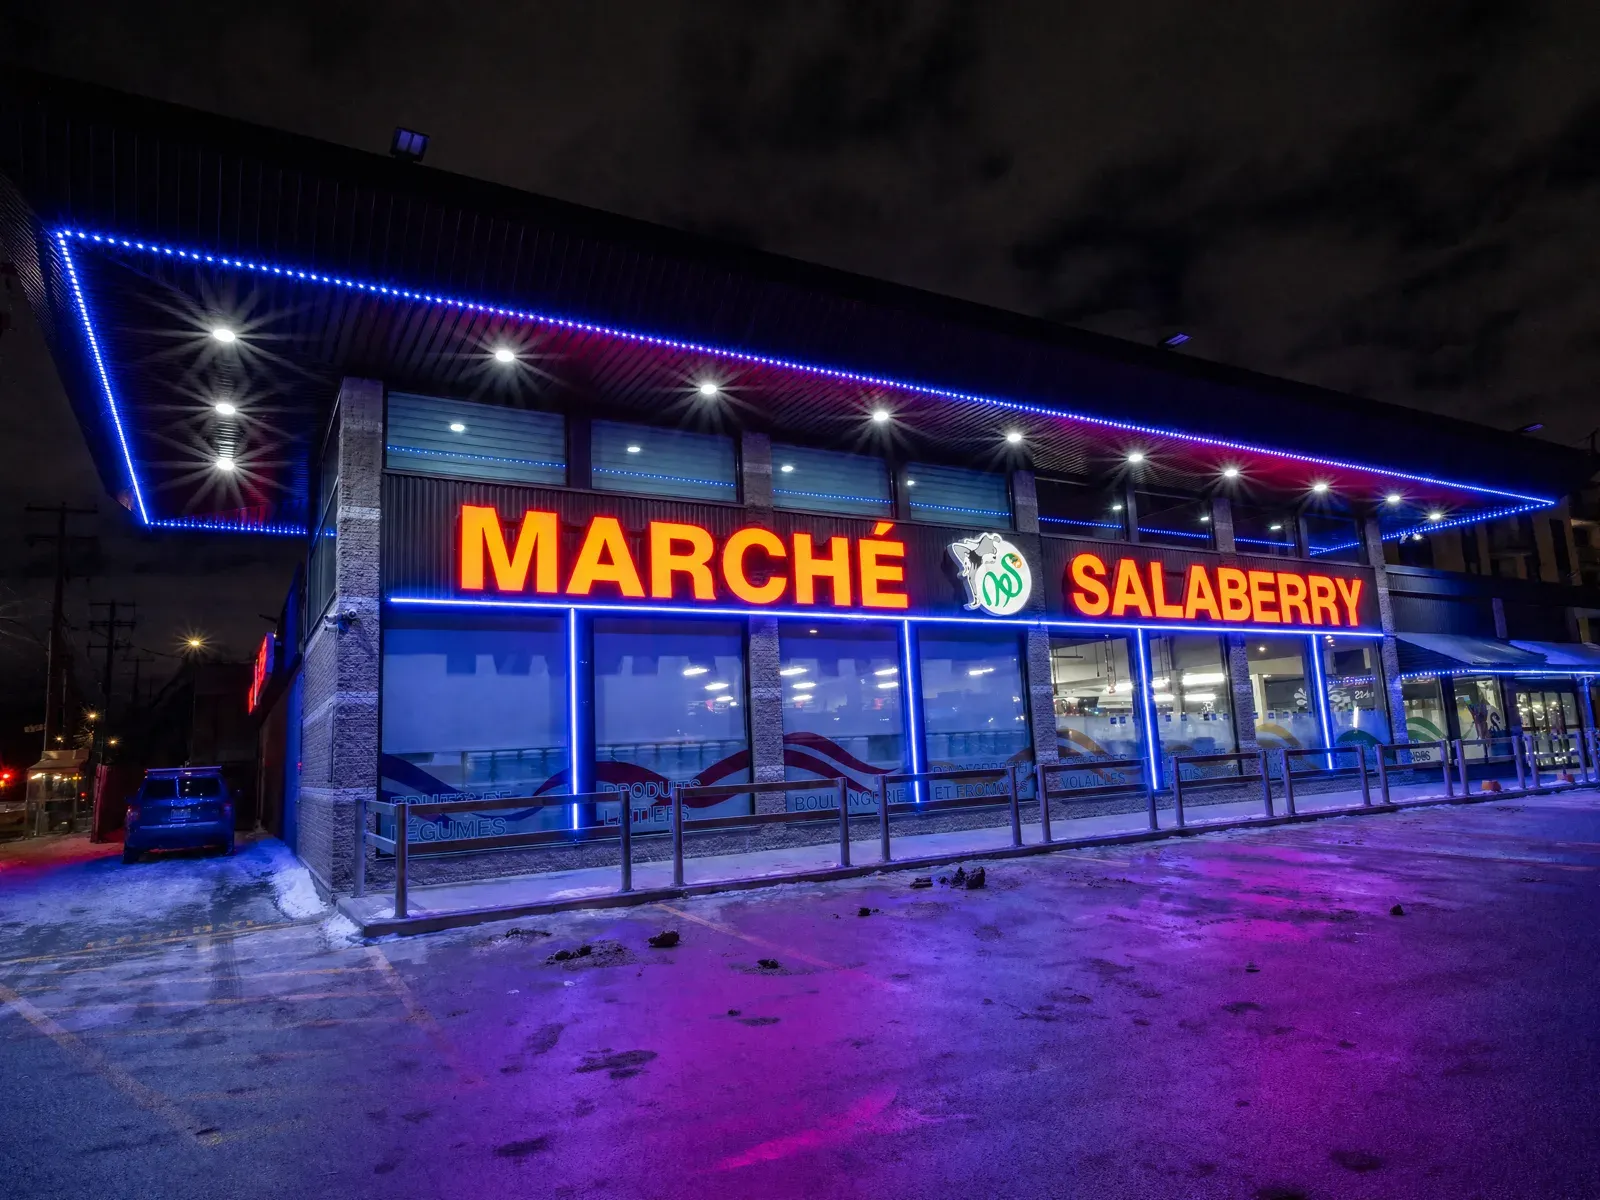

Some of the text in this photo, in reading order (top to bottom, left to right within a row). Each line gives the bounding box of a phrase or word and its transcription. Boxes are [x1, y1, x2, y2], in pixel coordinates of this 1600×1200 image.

[460, 505, 1362, 627] MARCHÉ SALABERRY
[795, 787, 906, 811] BOULNGERIE
[935, 786, 951, 800] ET
